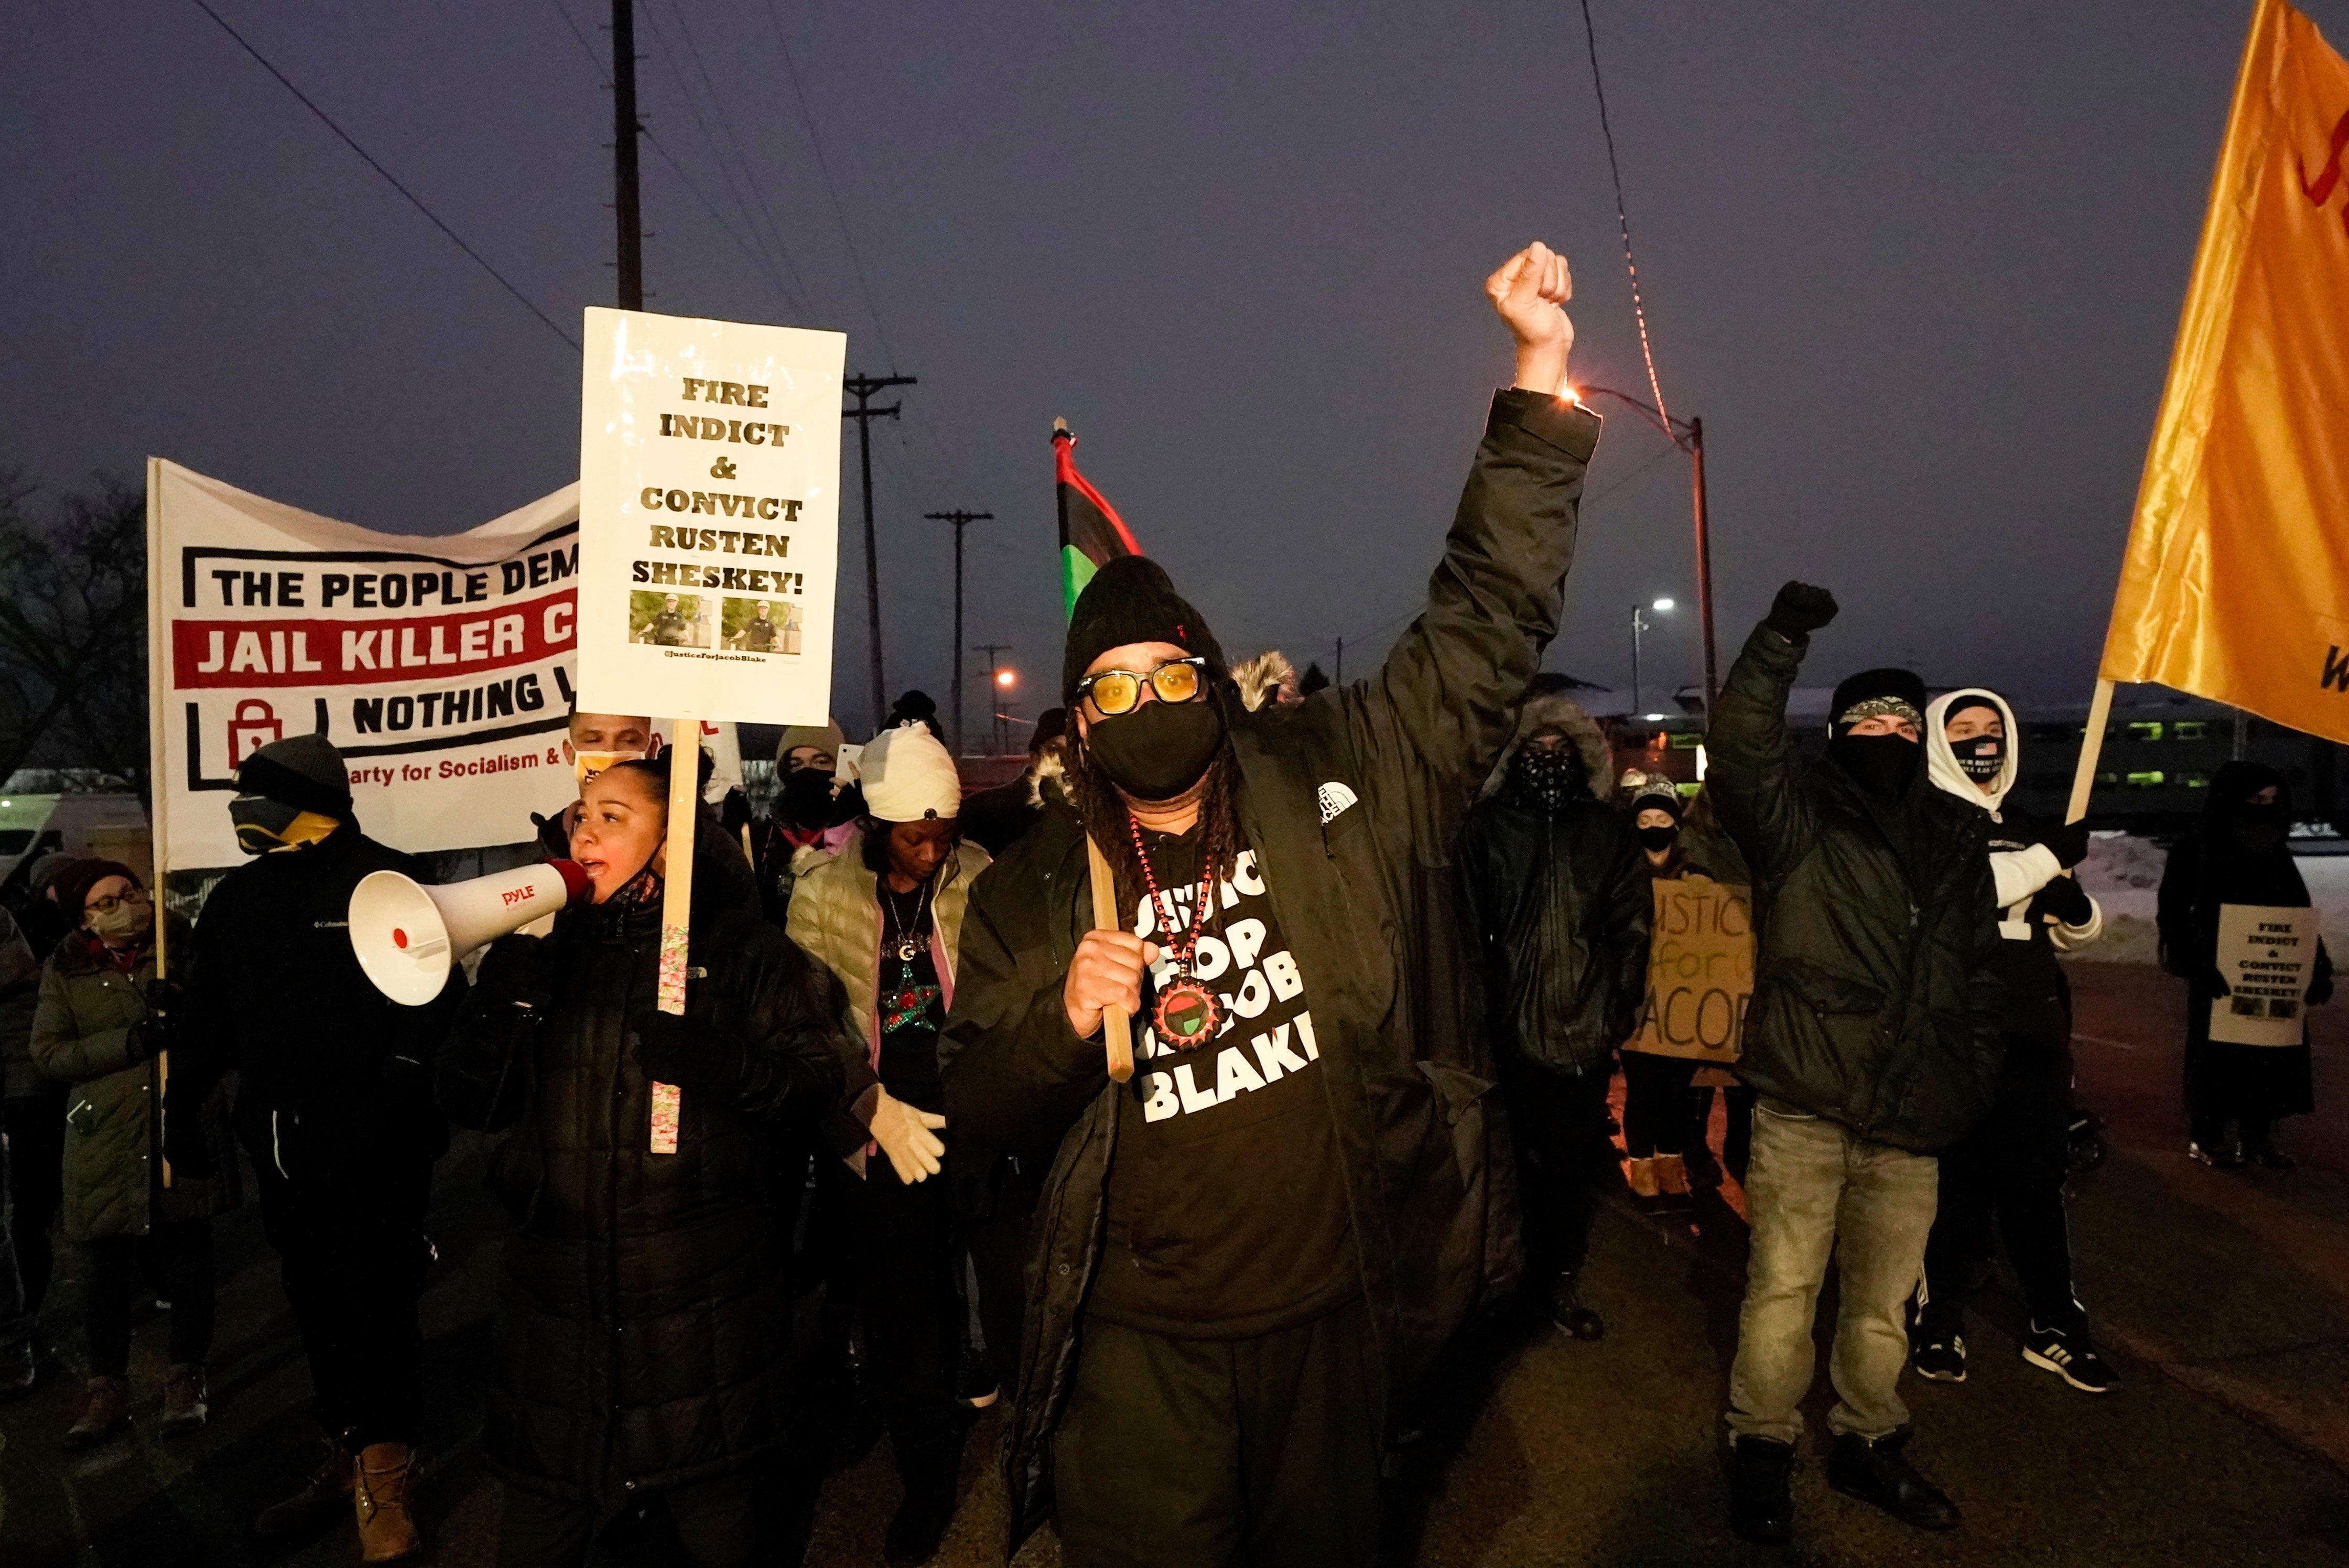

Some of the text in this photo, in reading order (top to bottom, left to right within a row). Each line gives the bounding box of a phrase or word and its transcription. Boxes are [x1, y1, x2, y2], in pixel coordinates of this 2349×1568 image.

[682, 377, 769, 408] FIRE
[659, 413, 789, 447] INDICT
[710, 456, 737, 480] &
[640, 486, 803, 522] CONVICT
[649, 525, 790, 558] RUSTEN
[211, 570, 305, 608] THE
[321, 572, 489, 608] PEOPLE
[632, 560, 804, 594] SHESKEY!
[198, 631, 322, 673] JAIL
[342, 614, 524, 672] KILLER
[664, 650, 767, 663] @JusticeForJacobBlake
[352, 673, 545, 733] NOTHING
[401, 764, 432, 782] for
[438, 754, 539, 779] Socialism
[546, 747, 560, 765] &
[502, 885, 535, 906] PYLE
